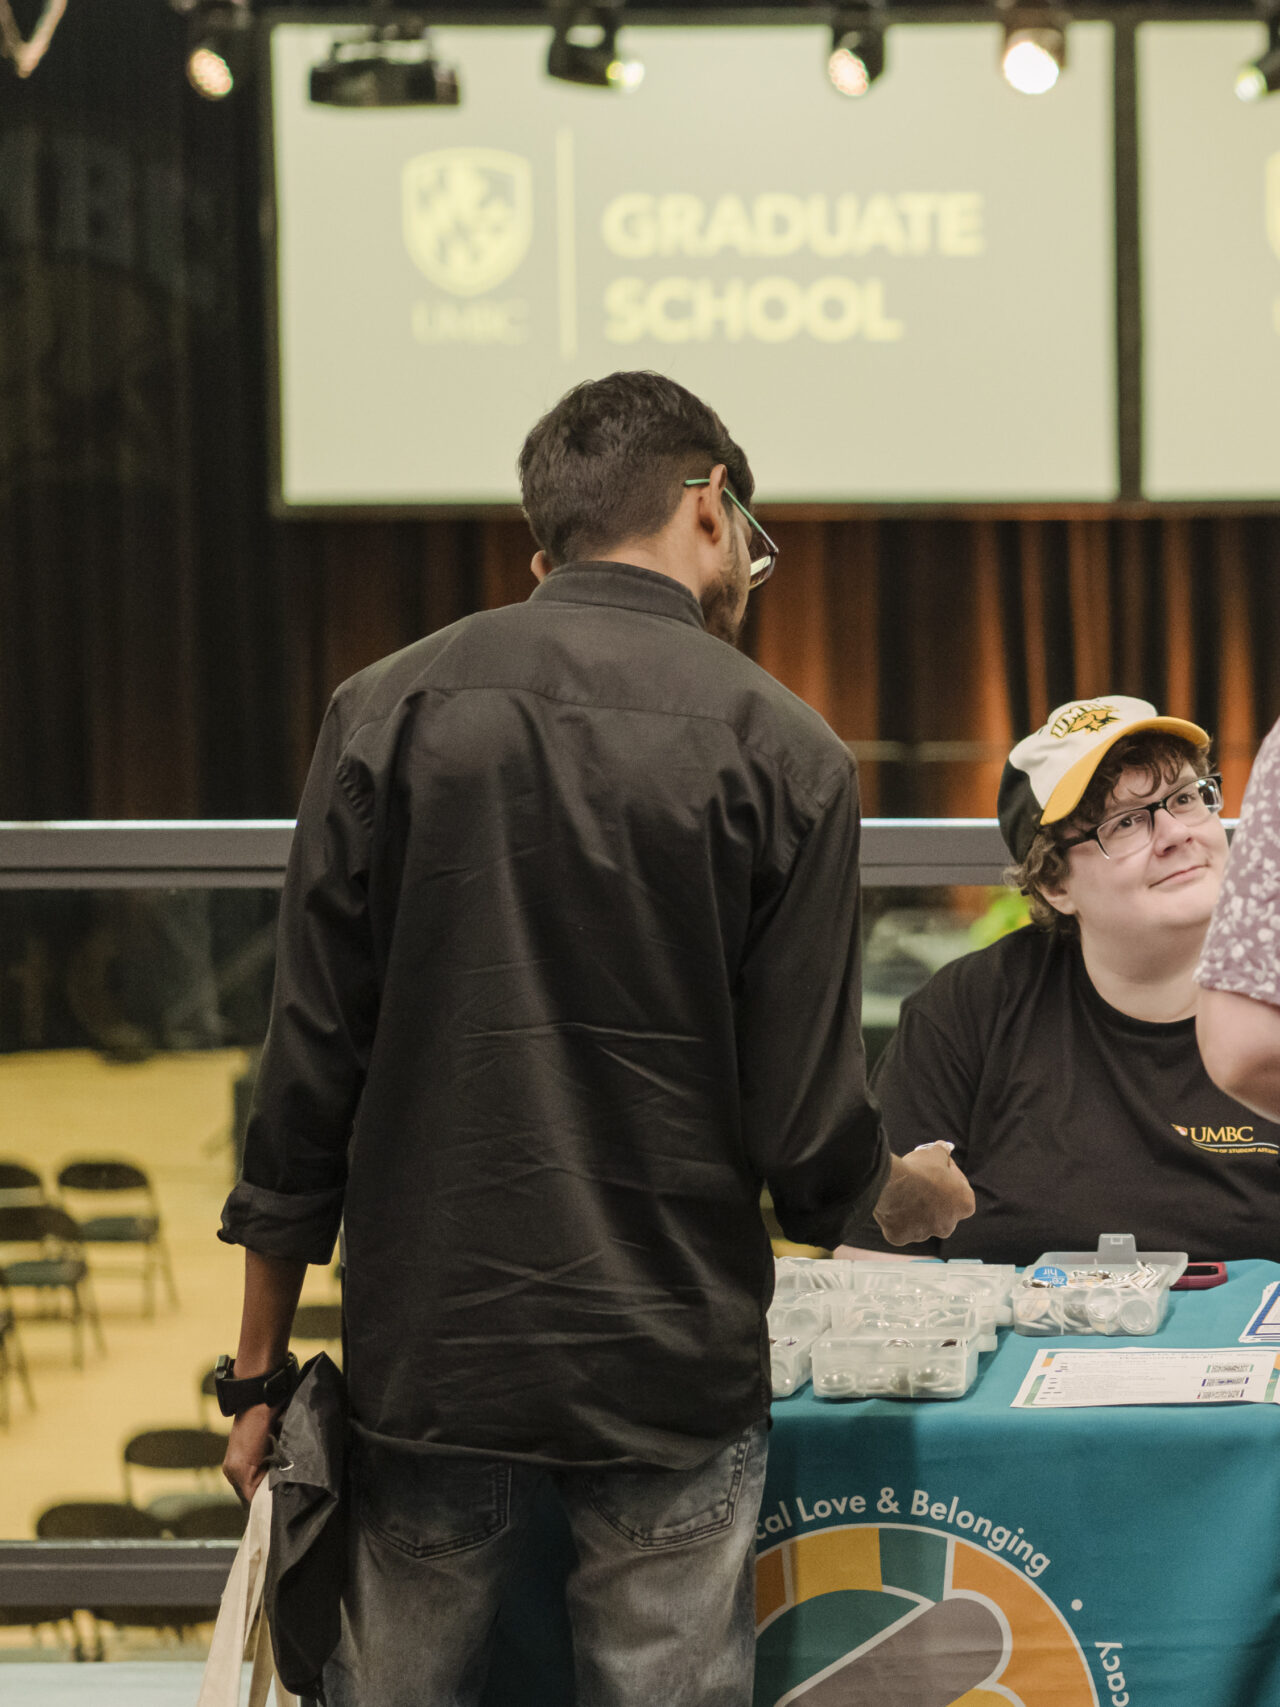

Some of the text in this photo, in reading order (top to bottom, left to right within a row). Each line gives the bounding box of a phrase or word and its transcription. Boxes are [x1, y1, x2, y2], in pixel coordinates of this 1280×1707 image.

[602, 191, 985, 259] GRADUATE
[604, 276, 903, 345] SCHOOL
[1190, 1126, 1254, 1143] UMBC
[796, 1495, 867, 1522] Love
[876, 1487, 900, 1514] &
[910, 1489, 1051, 1578] Belonging
